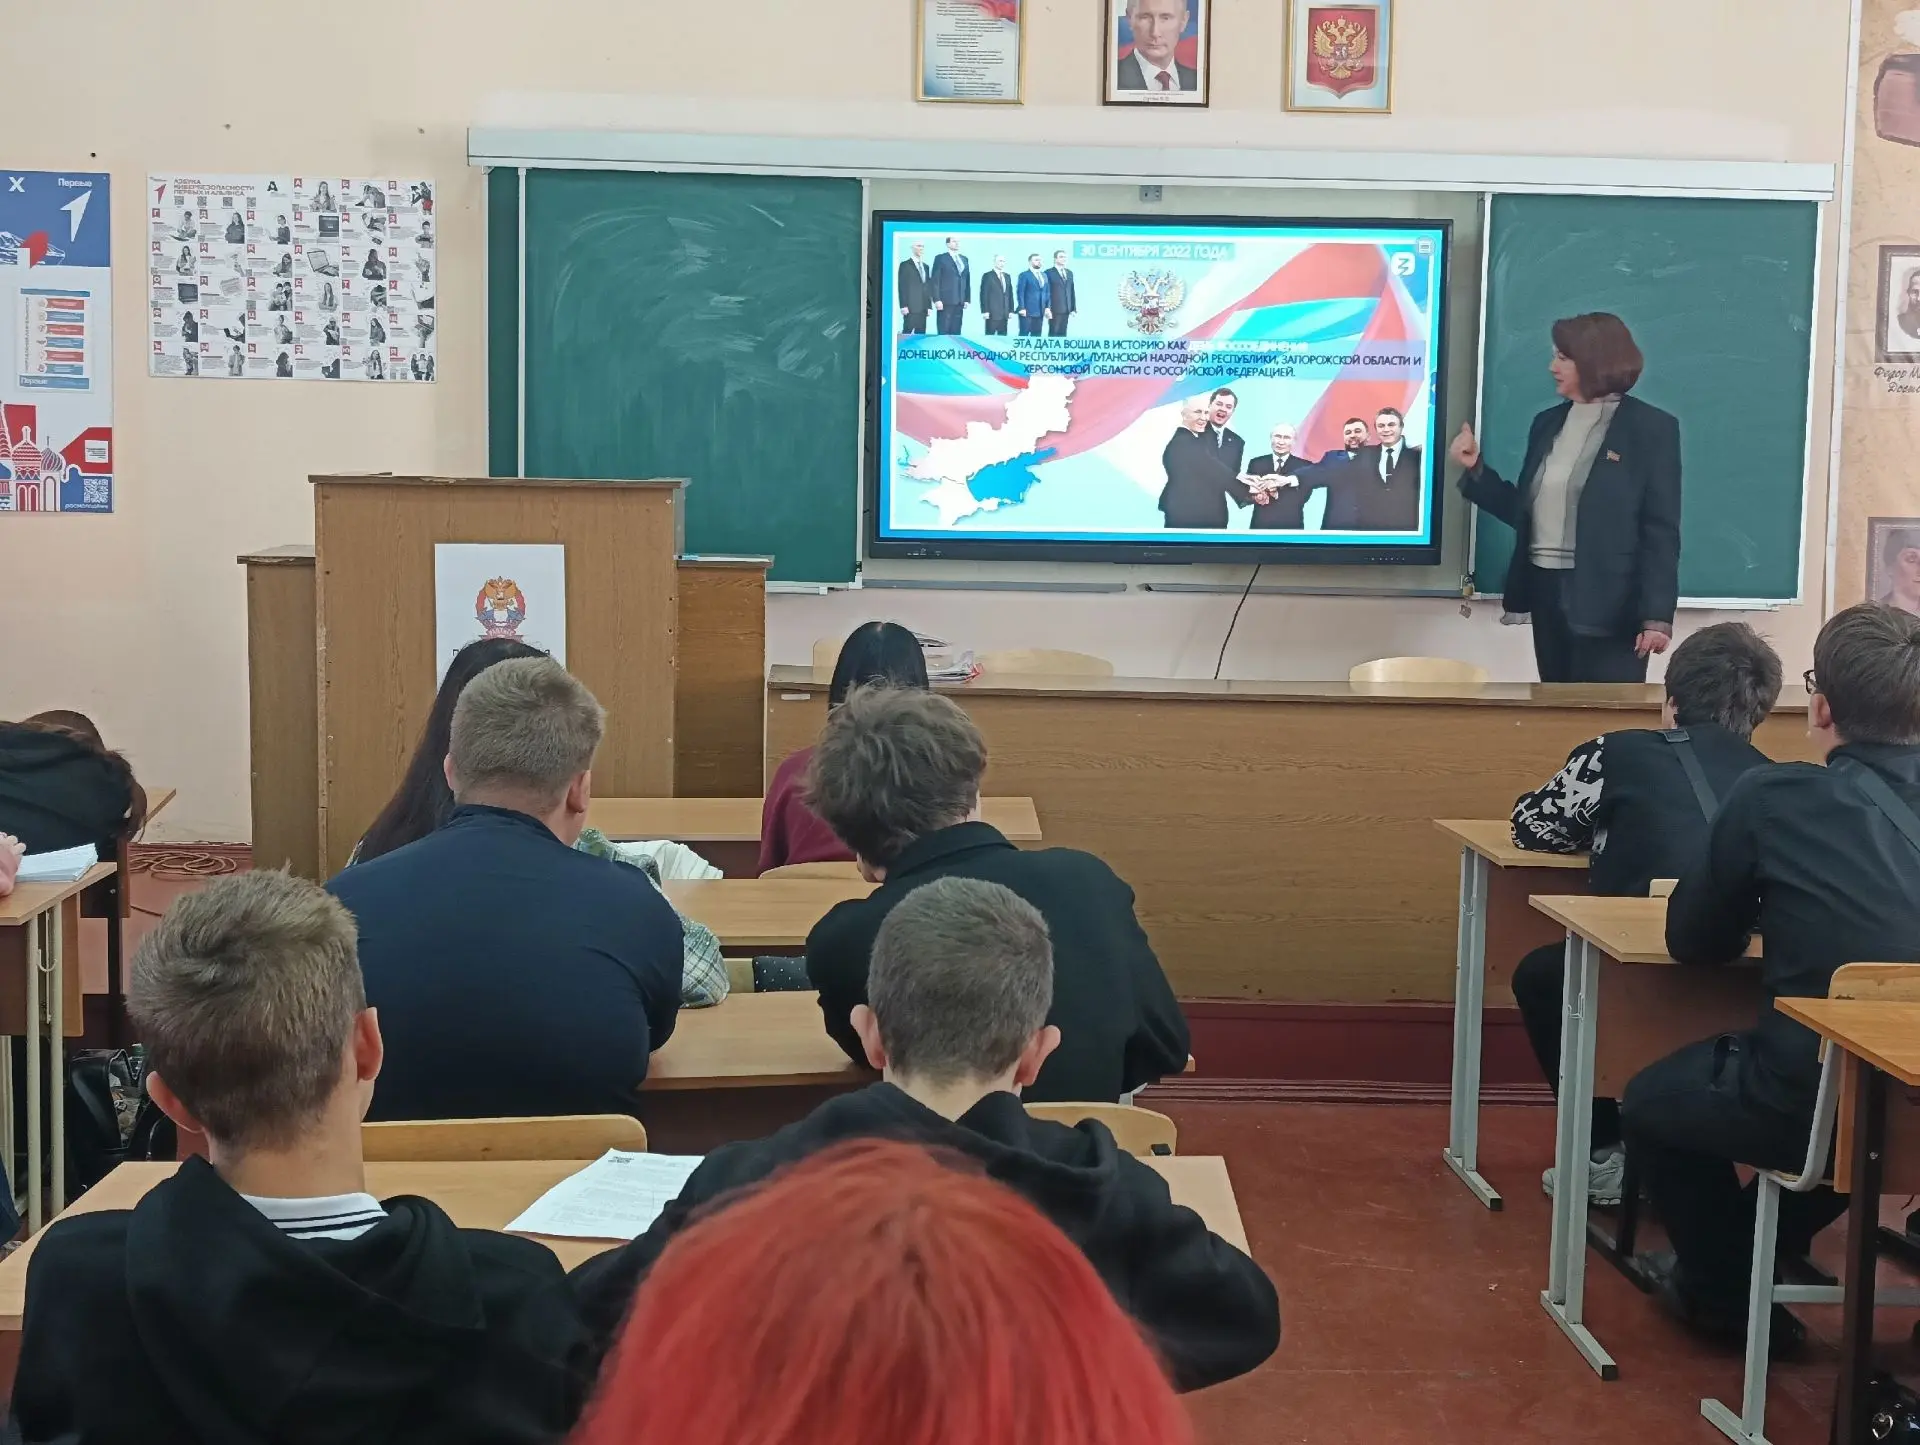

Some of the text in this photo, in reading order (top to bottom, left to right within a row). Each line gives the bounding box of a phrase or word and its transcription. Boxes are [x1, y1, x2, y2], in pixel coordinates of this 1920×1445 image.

[58, 178, 92, 188] Первые
[1163, 245, 1191, 258] 2022
[1013, 338, 1032, 349] ЭТА
[1034, 338, 1061, 350] ДАТА
[1064, 339, 1101, 350] ВОШЛА
[1104, 340, 1110, 350] В
[1113, 340, 1164, 351] ИСТОРИЮ
[1168, 341, 1186, 351] КАК
[898, 348, 956, 361] ДОНЕЦКОЙ
[958, 349, 1017, 361] НАРОДНОЙ
[1090, 350, 1147, 363] ЛУГАНСКОЙ
[1150, 351, 1208, 364] НАРОДНОЙ
[1211, 353, 1279, 366] РЕСПУБЛИКИ,
[1281, 353, 1360, 366] ЗАПОРОЖСКОЙ
[1363, 355, 1410, 366] ОБЛАСТИ
[1413, 355, 1422, 366] И
[1023, 362, 1296, 378] ХЕРСОНСКОЙ ОБЛАСТИ С РОССИЙСКОЙ ФЕДЕРАЦИЕЙ.
